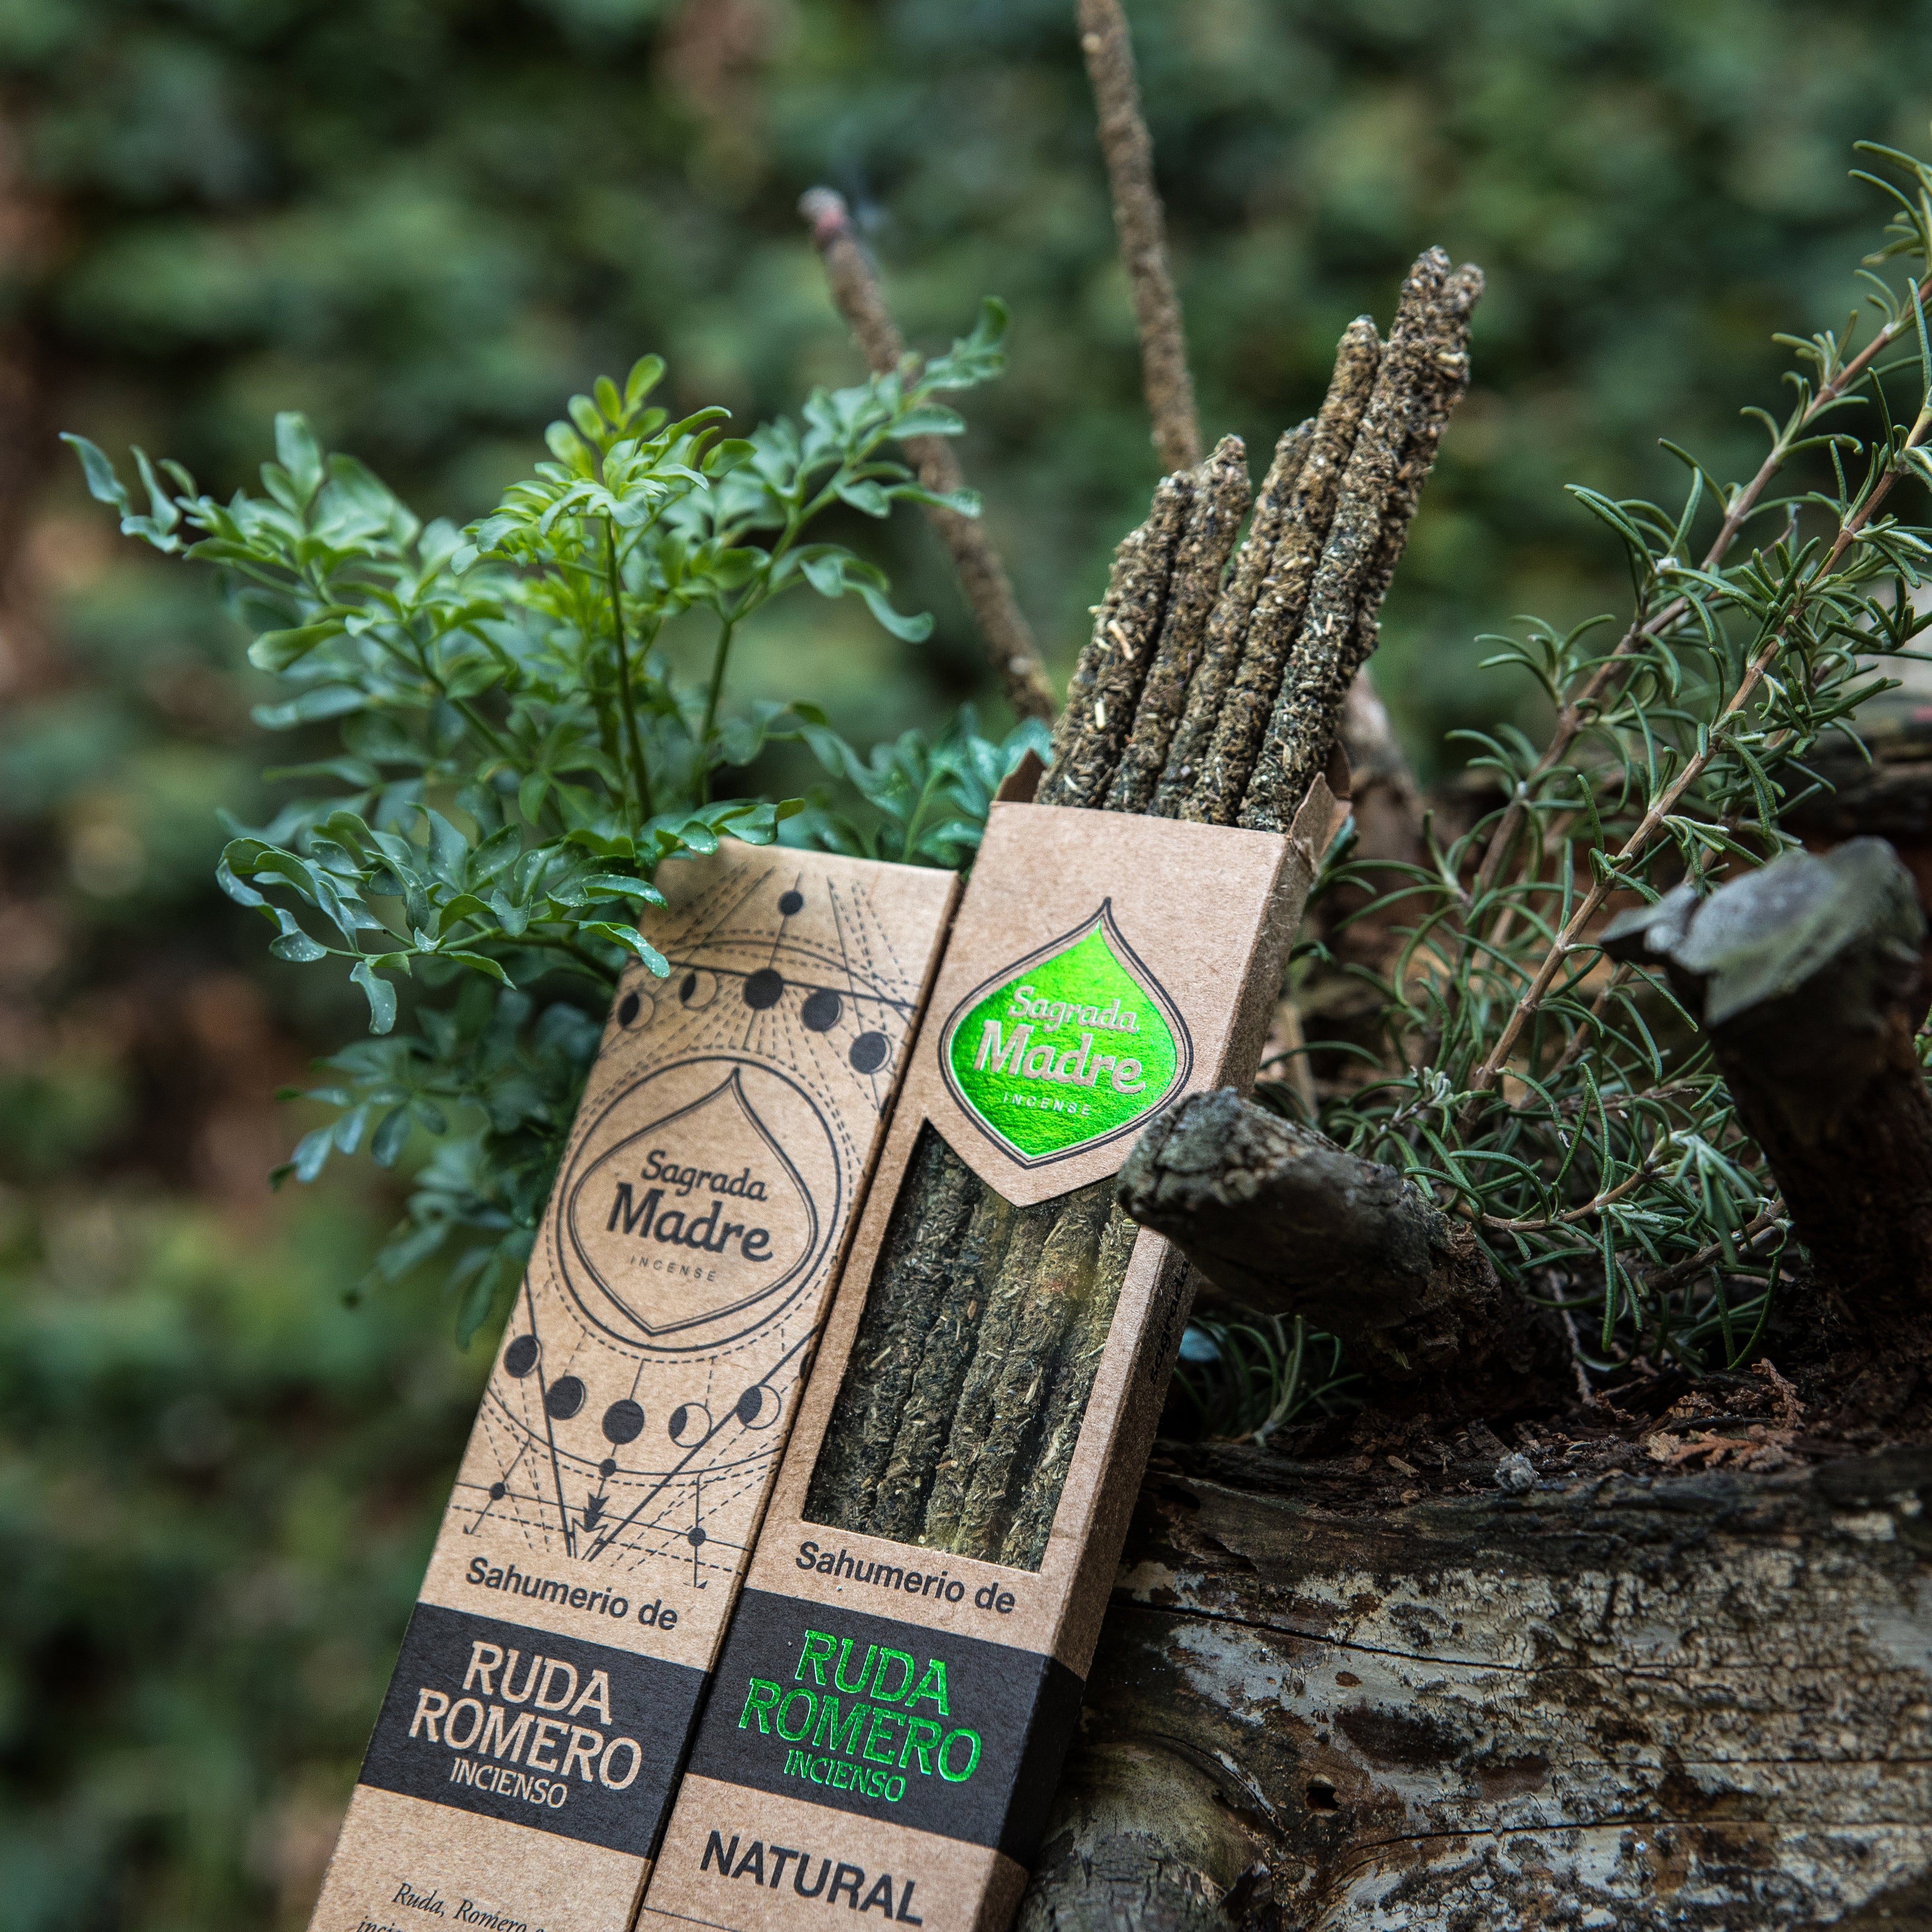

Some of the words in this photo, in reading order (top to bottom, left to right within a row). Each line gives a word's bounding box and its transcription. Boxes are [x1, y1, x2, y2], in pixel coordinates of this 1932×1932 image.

[1007, 986, 1140, 1033] Sagrada
[973, 1019, 1146, 1094] Madre
[1003, 1092, 1091, 1116] INCENSE
[641, 1150, 768, 1201] Sagrada
[606, 1182, 773, 1262] Madre
[630, 1255, 716, 1281] INCENSE
[466, 1557, 628, 1618] Sahumerio
[637, 1599, 678, 1631] de
[795, 1541, 964, 1602] Sahumerio
[975, 1582, 1015, 1614] de
[462, 1641, 612, 1725] RUDA
[795, 1629, 950, 1716] RUDA
[409, 1687, 642, 1790] ROMERO
[738, 1677, 981, 1783] ROMERO
[449, 1757, 568, 1808] INCIENSO
[783, 1749, 906, 1802] INCIENSO
[391, 1882, 445, 1918] Ruda,
[453, 1899, 527, 1932] Romero
[699, 1830, 923, 1926] NATURAL
